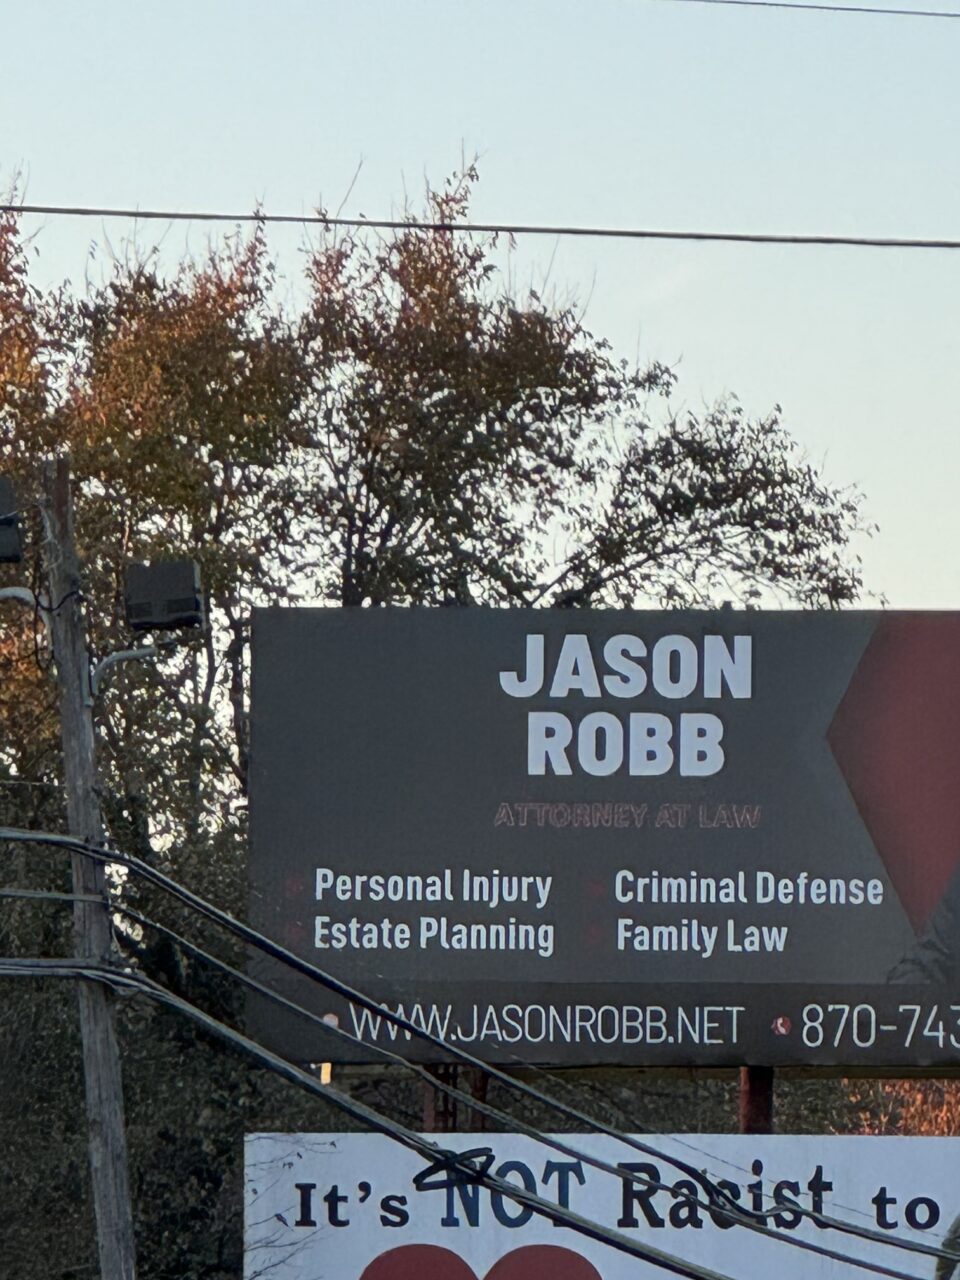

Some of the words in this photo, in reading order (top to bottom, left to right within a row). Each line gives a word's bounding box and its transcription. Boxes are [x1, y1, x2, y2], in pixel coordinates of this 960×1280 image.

[499, 633, 752, 699] JASON
[527, 711, 725, 777] ROBB
[494, 802, 650, 827] ATTORNEY
[655, 803, 691, 828] AT
[699, 804, 762, 829] LAW
[315, 868, 454, 902] Personal
[463, 869, 553, 908] Injury
[615, 870, 746, 904] Criminal
[756, 871, 884, 905] Defense
[314, 916, 411, 949] Estate
[420, 917, 555, 958] Planning
[617, 918, 719, 959] Family
[727, 920, 788, 953] Law
[348, 1004, 745, 1045] WWW.JASONROBB.NET
[441, 1160, 586, 1228] NOT
[617, 1159, 834, 1230] Racist
[872, 1186, 941, 1230] to
